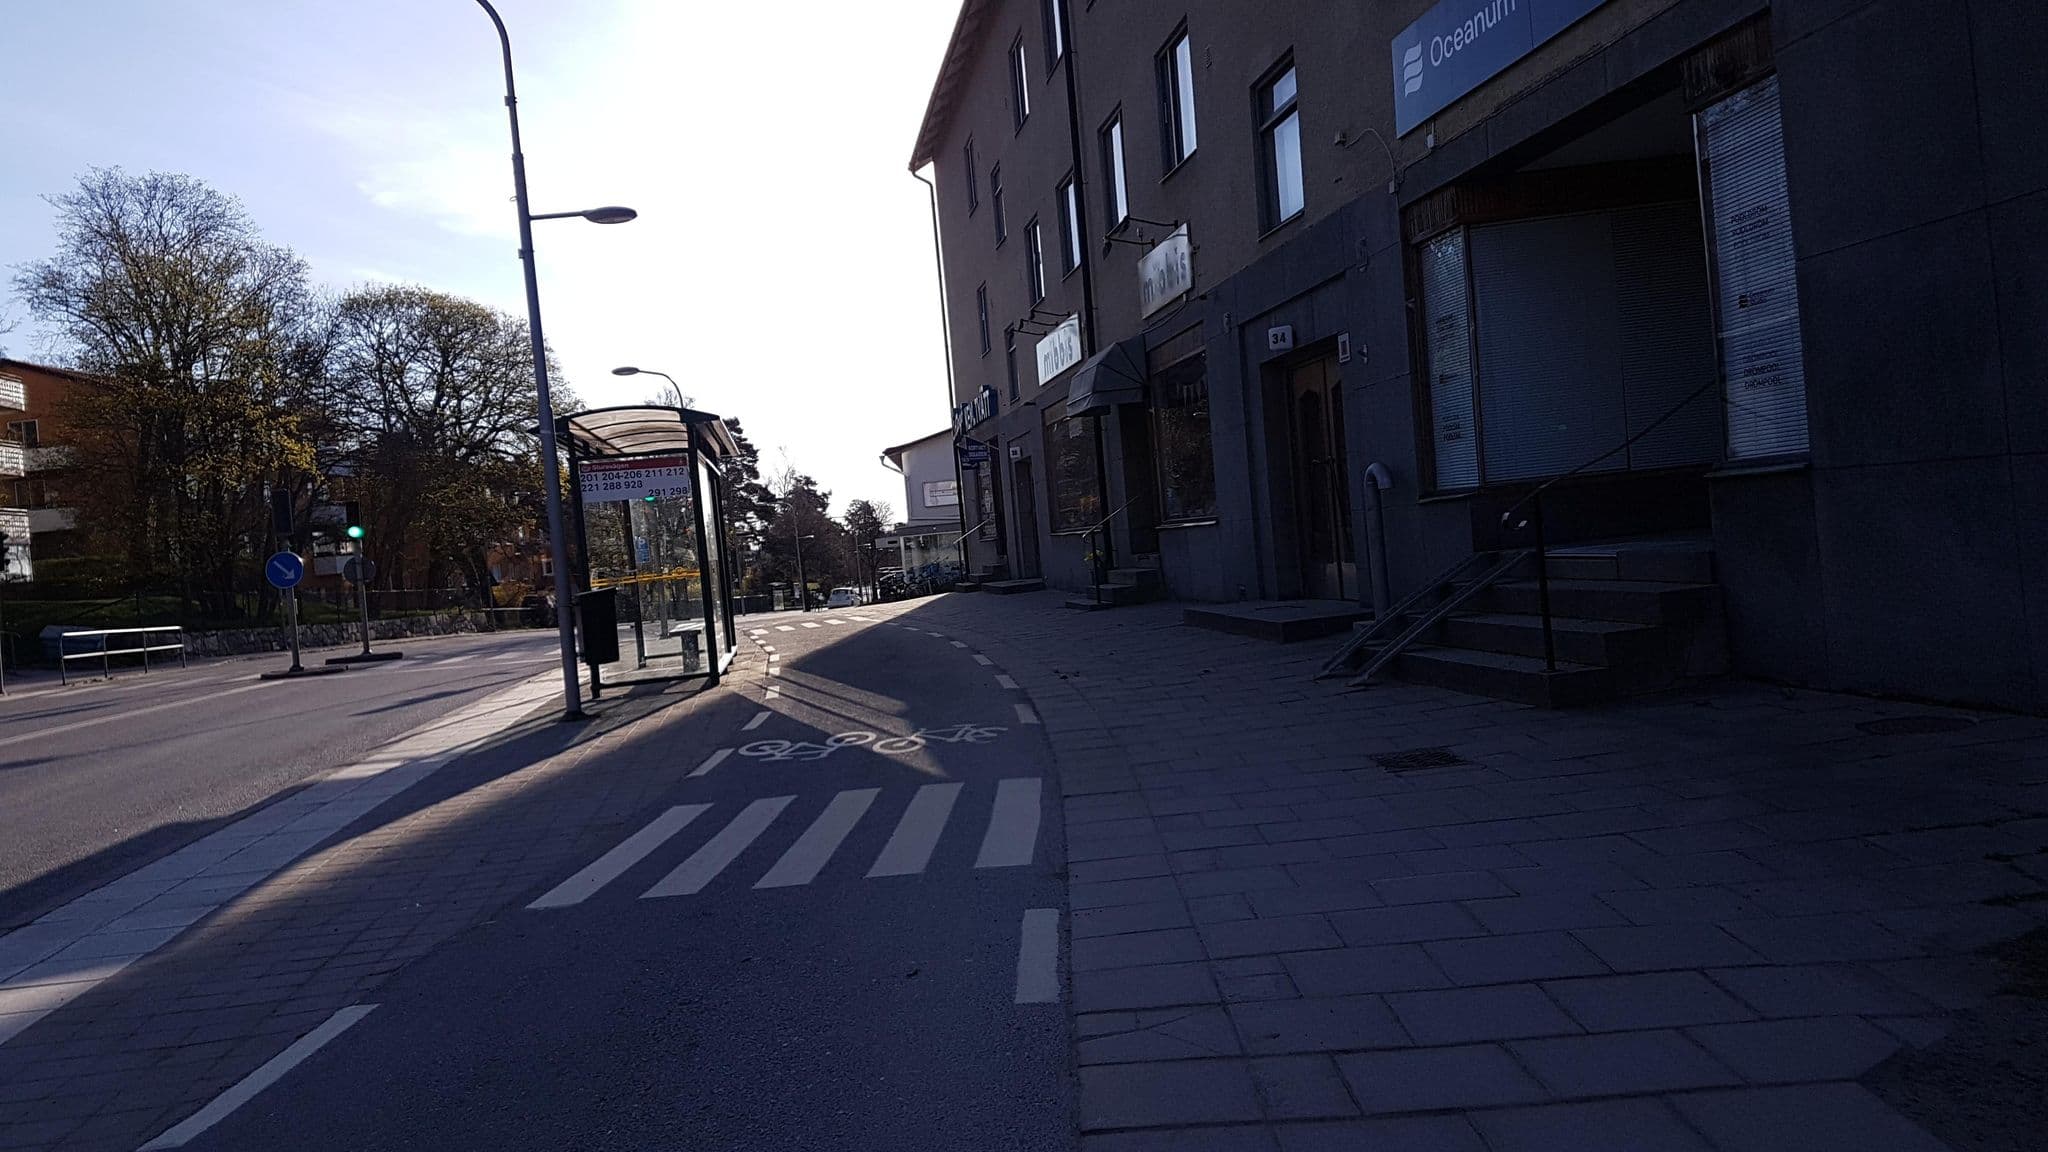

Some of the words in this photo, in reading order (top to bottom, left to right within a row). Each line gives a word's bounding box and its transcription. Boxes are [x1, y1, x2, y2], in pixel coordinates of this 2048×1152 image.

[1430, 0, 1516, 67] Oceanum
[580, 474, 598, 482] 201
[602, 471, 642, 481] 204-206
[645, 469, 662, 478] 211
[666, 468, 684, 476] 212
[581, 483, 599, 492] 221
[648, 488, 666, 497] 291
